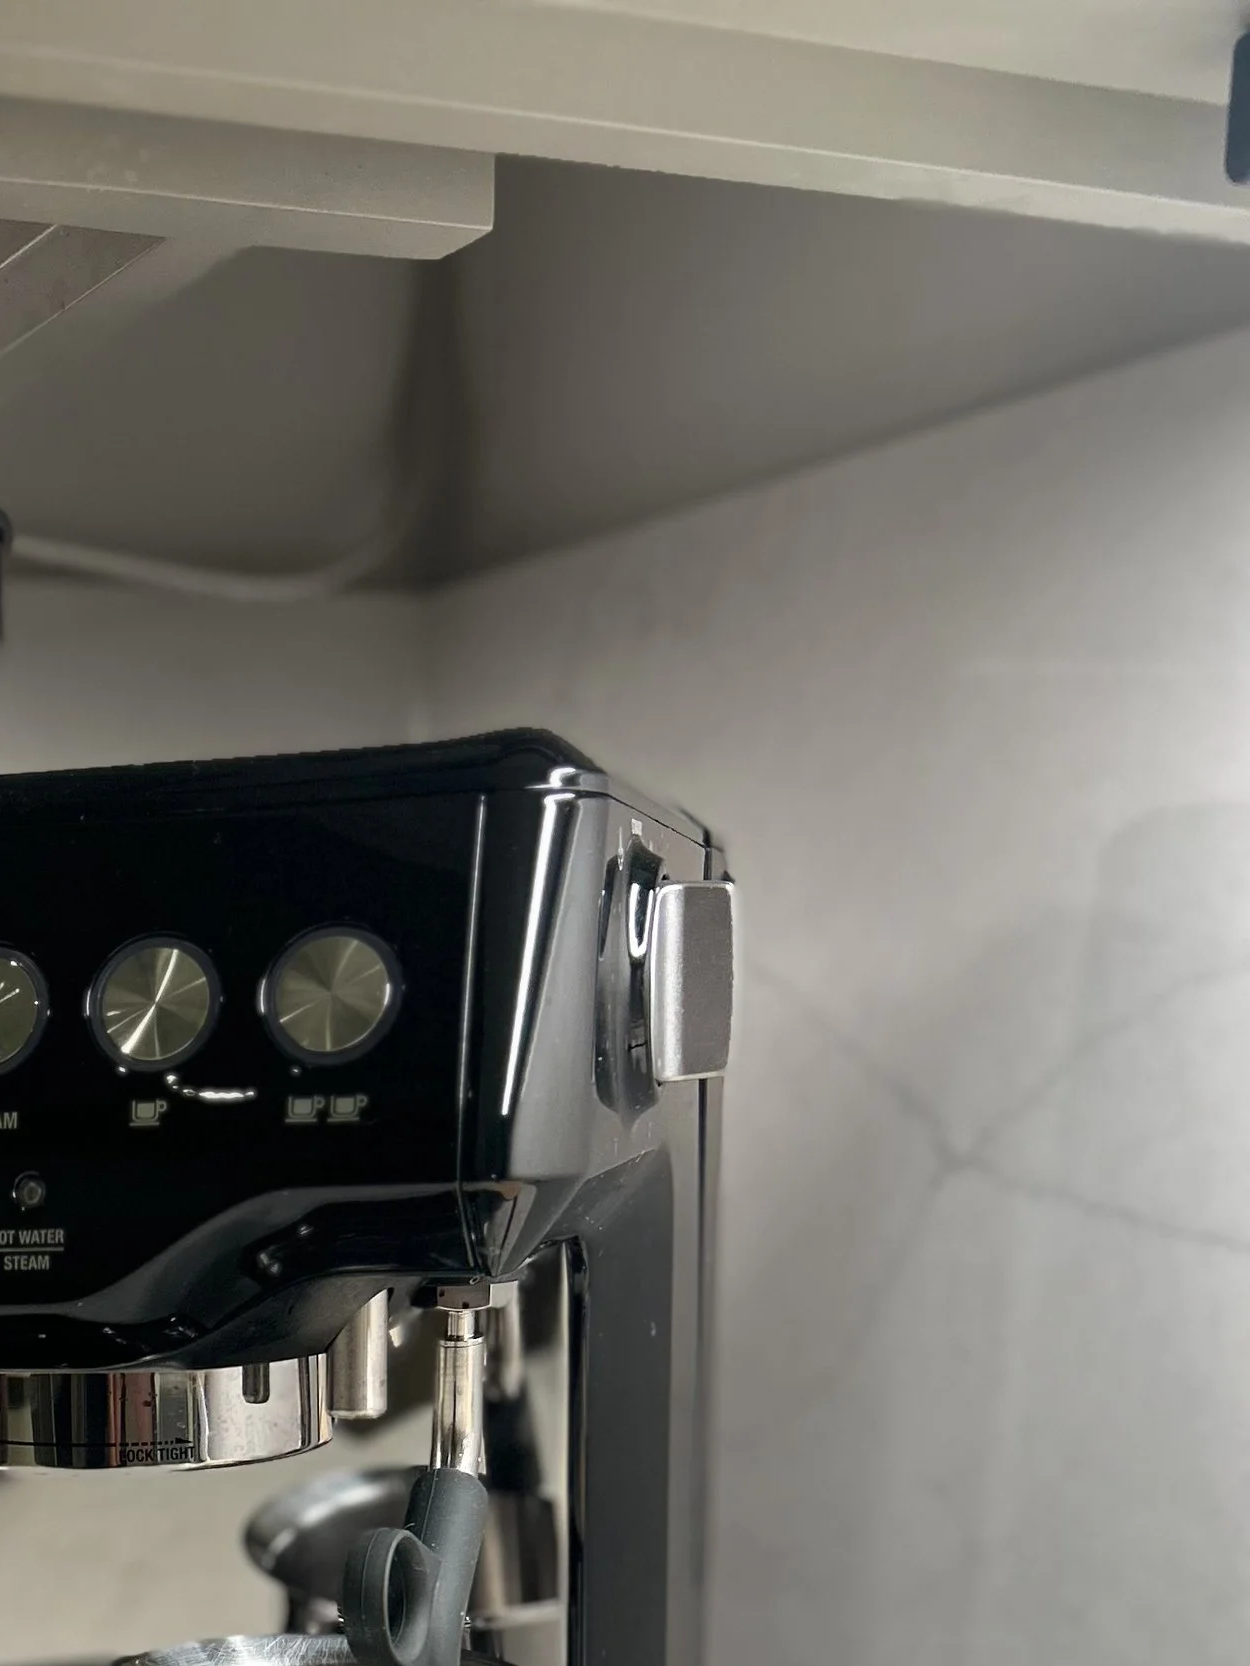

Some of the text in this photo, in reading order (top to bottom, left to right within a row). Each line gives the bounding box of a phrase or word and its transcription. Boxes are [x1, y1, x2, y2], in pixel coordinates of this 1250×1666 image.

[19, 1228, 65, 1245] WATER
[4, 1255, 50, 1270] STEAM
[157, 1446, 195, 1461] TIGHT
